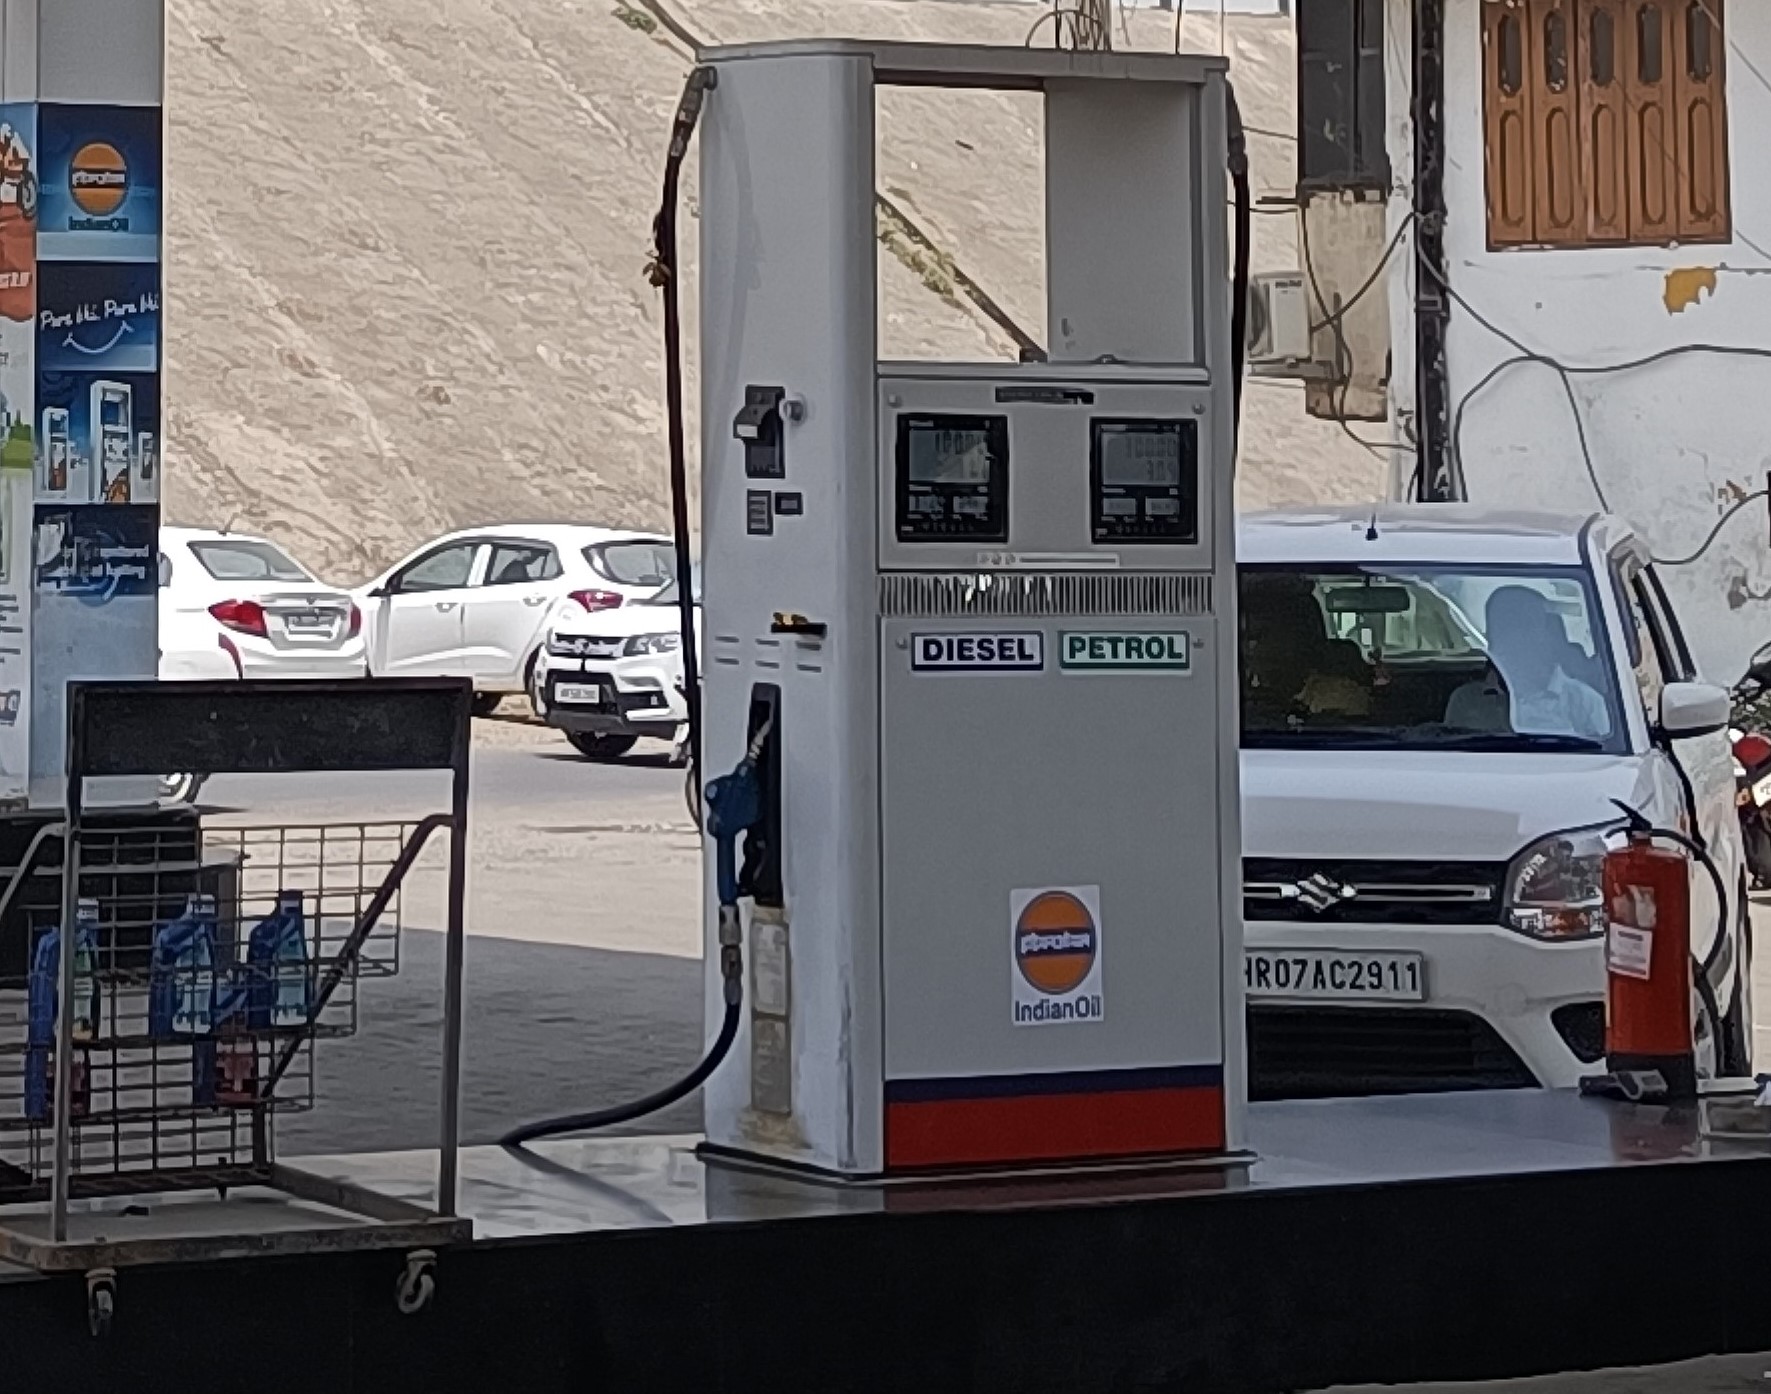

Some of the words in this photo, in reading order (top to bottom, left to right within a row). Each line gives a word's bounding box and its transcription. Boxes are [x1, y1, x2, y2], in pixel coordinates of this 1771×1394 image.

[922, 638, 1034, 661] DIESEL
[1068, 636, 1184, 660] PETROL
[1015, 994, 1102, 1022] IndianOil
